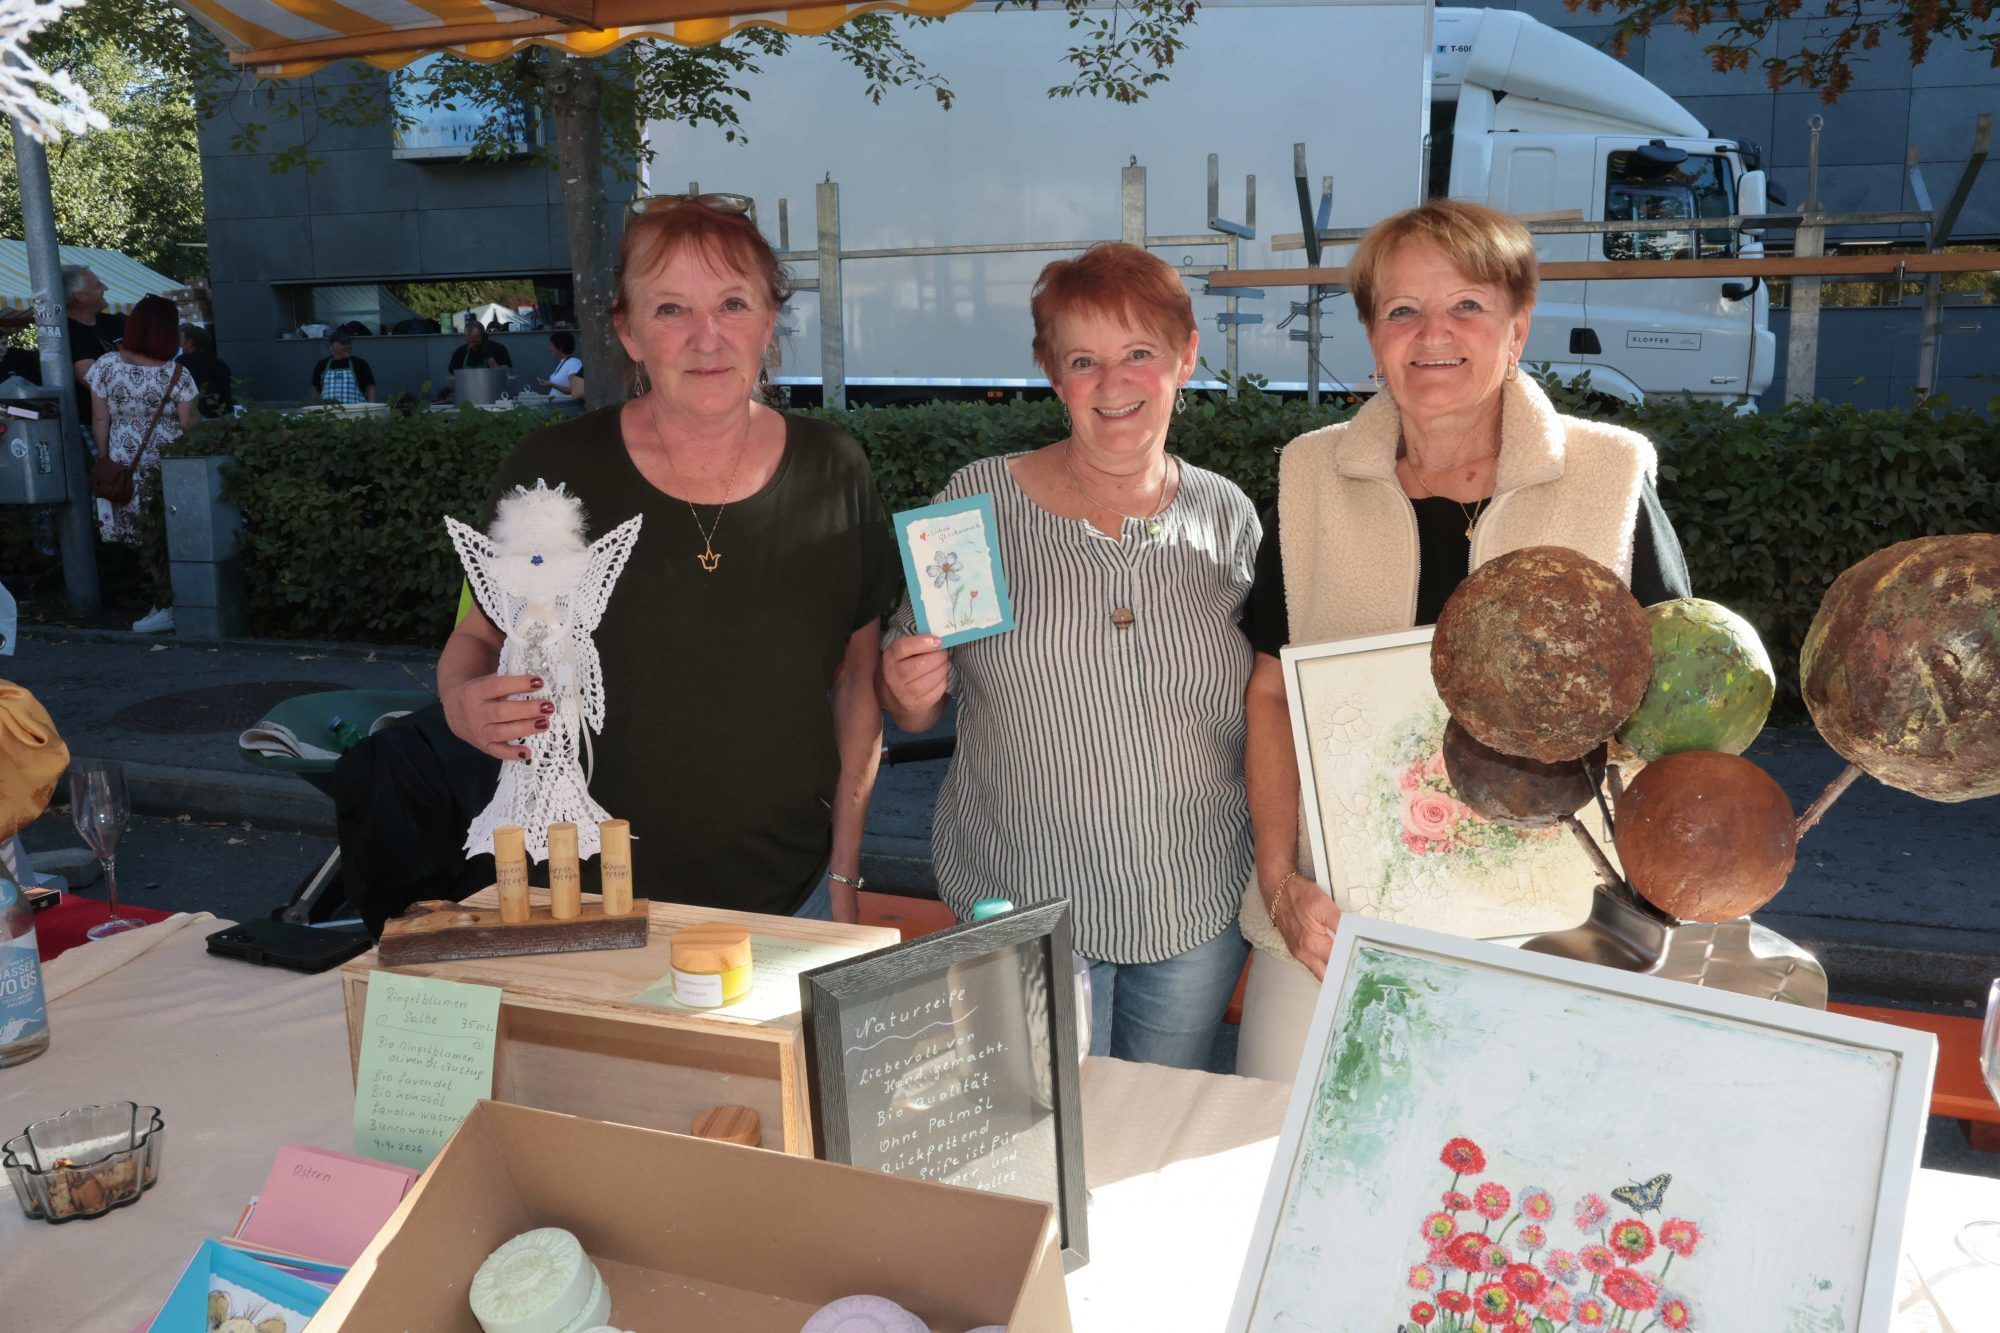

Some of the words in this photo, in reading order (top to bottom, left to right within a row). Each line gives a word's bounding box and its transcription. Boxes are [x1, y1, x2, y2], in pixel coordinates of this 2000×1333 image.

[1632, 336, 1670, 345] KLOPFER
[385, 986, 468, 1011] Ringelblumen
[403, 1011, 438, 1025] Salbe
[856, 988, 966, 1039] Naturseife
[377, 1035, 394, 1049] Bio
[400, 1041, 474, 1063] Ringelblumen
[859, 1044, 938, 1086] Liebevoll
[947, 1032, 975, 1049] von
[373, 1069, 393, 1082] Bio
[398, 1071, 453, 1091] Lavendel
[371, 1084, 391, 1098] Bio
[372, 1101, 416, 1118] Lanolin
[876, 1107, 904, 1127] Bio
[879, 1130, 919, 1153] Ohne
[966, 1141, 986, 1160] ist
[990, 1131, 1021, 1159] für
[991, 1149, 1017, 1169] und
[293, 1164, 332, 1182] Ostern
